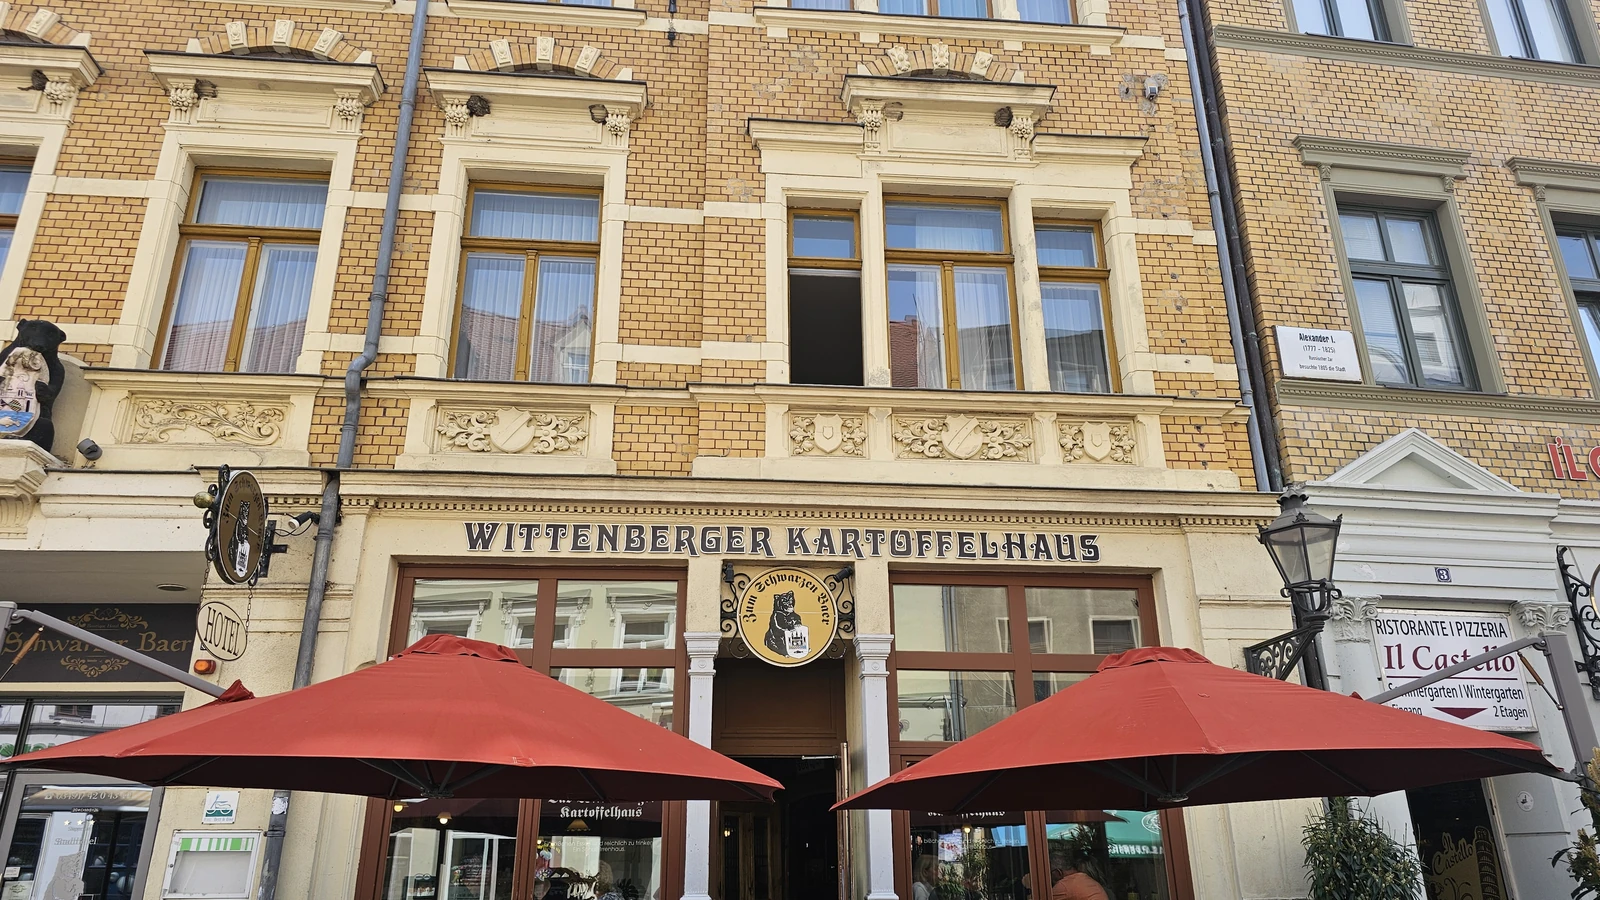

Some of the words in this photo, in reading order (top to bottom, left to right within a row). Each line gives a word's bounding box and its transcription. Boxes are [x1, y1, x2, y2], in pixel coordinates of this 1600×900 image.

[1299, 333, 1330, 343] Alexander
[463, 521, 776, 557] WITTENBERGER
[785, 526, 1101, 563] KARTOFFELHAUS
[743, 595, 758, 623] Zum
[754, 573, 819, 593] Schwarzen
[817, 592, 830, 625] Baer
[204, 606, 240, 657] HOTEL
[1375, 619, 1449, 637] RISTORANTE
[1456, 621, 1508, 638] PIZZERIA
[136, 631, 192, 652] Baer
[1383, 643, 1406, 670] Il
[1388, 682, 1459, 702] Smergarten
[1463, 684, 1525, 703] Wintergarten
[1493, 705, 1499, 718] 2
[1499, 706, 1529, 721] Etagen
[560, 805, 643, 820] Kartoffelhaus
